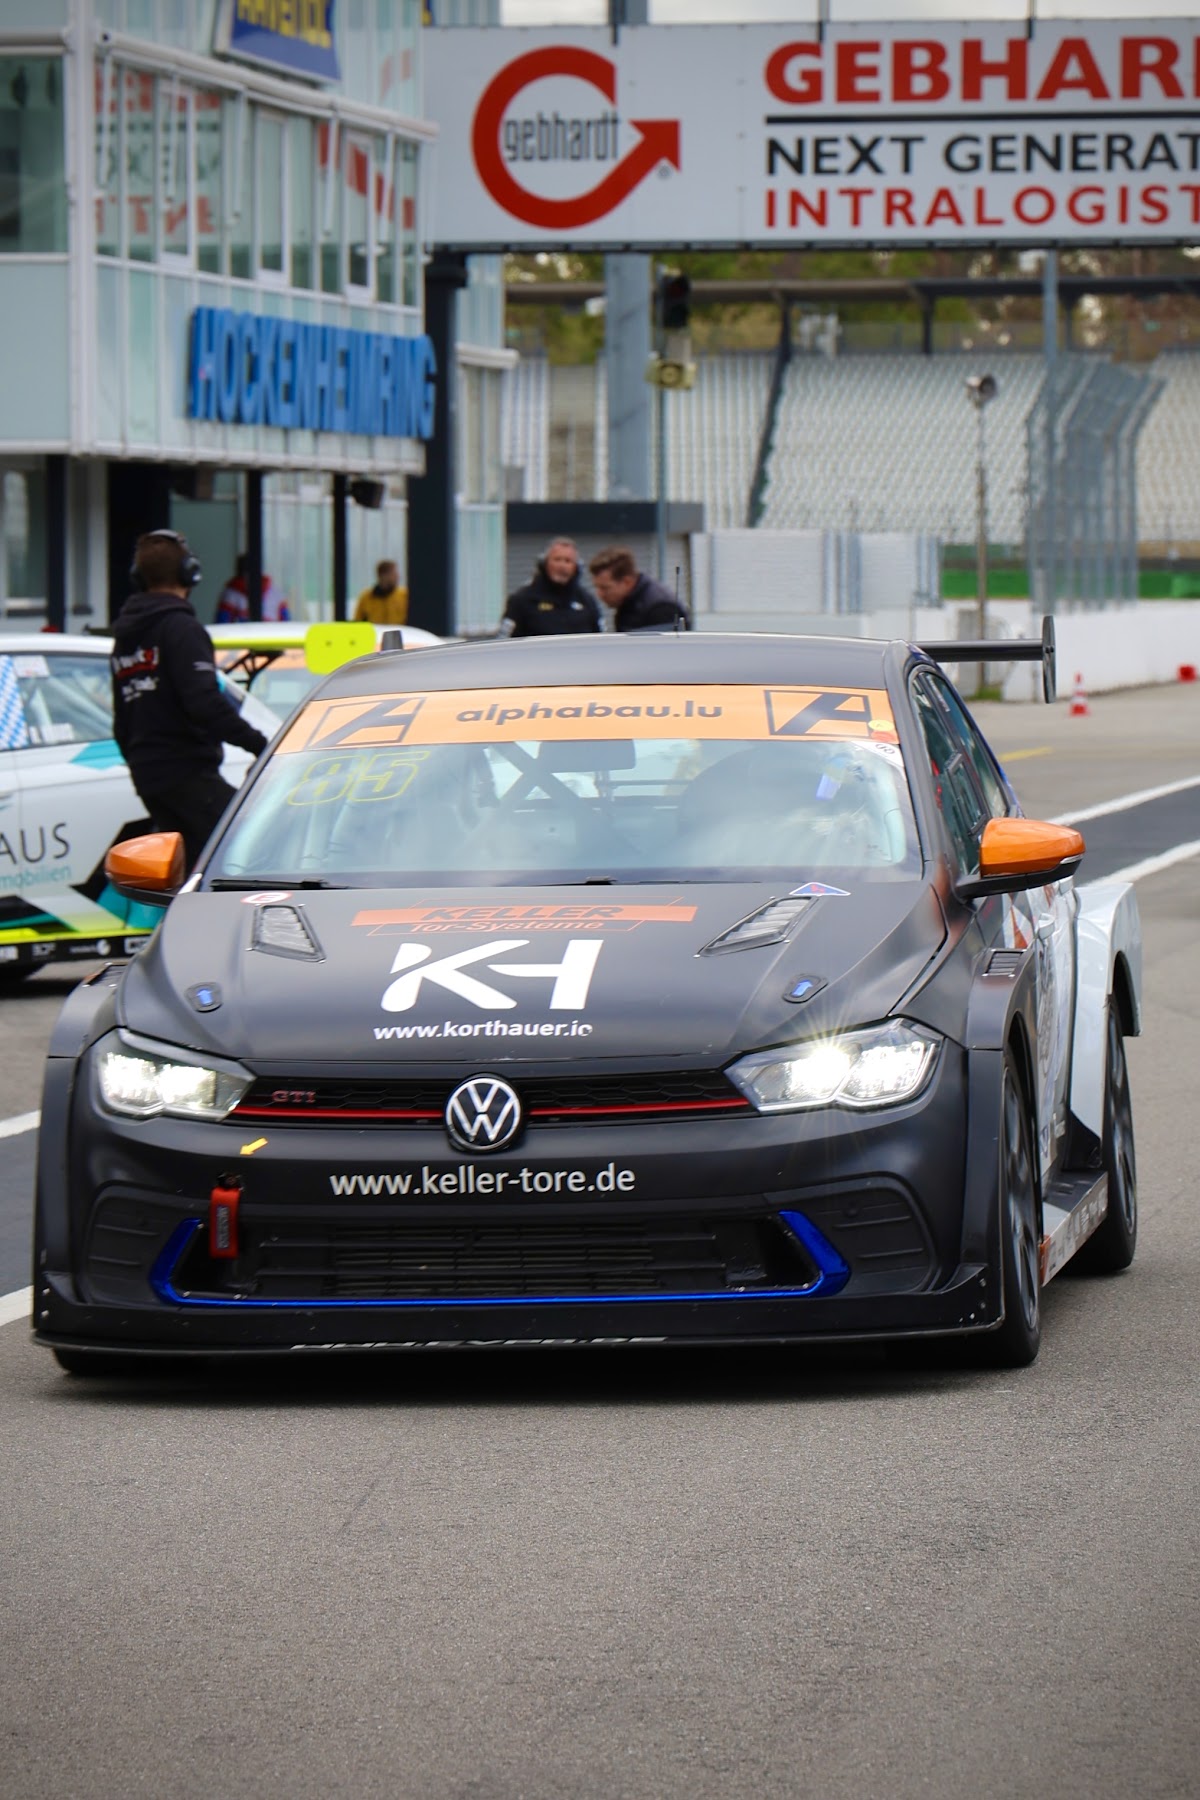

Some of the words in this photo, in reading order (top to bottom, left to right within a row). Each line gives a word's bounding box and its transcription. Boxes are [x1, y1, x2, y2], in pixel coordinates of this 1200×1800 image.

[763, 37, 1200, 104] GEBHAR
[504, 111, 620, 162] gebhardt
[766, 135, 924, 176] NEXT
[943, 132, 1200, 174] GENERAT
[766, 184, 1200, 229] INTRALOGIST
[188, 305, 437, 440] HOCKENHEIMRING
[456, 700, 722, 726] alphabau.lu
[288, 750, 430, 806] 85
[0, 822, 70, 865] AUS
[409, 920, 604, 933] Tor-Systeme
[420, 905, 625, 921] KELLER
[380, 939, 604, 1012] KH
[271, 1089, 317, 1104] GTI
[329, 1162, 635, 1196] www.keller-tore.de
